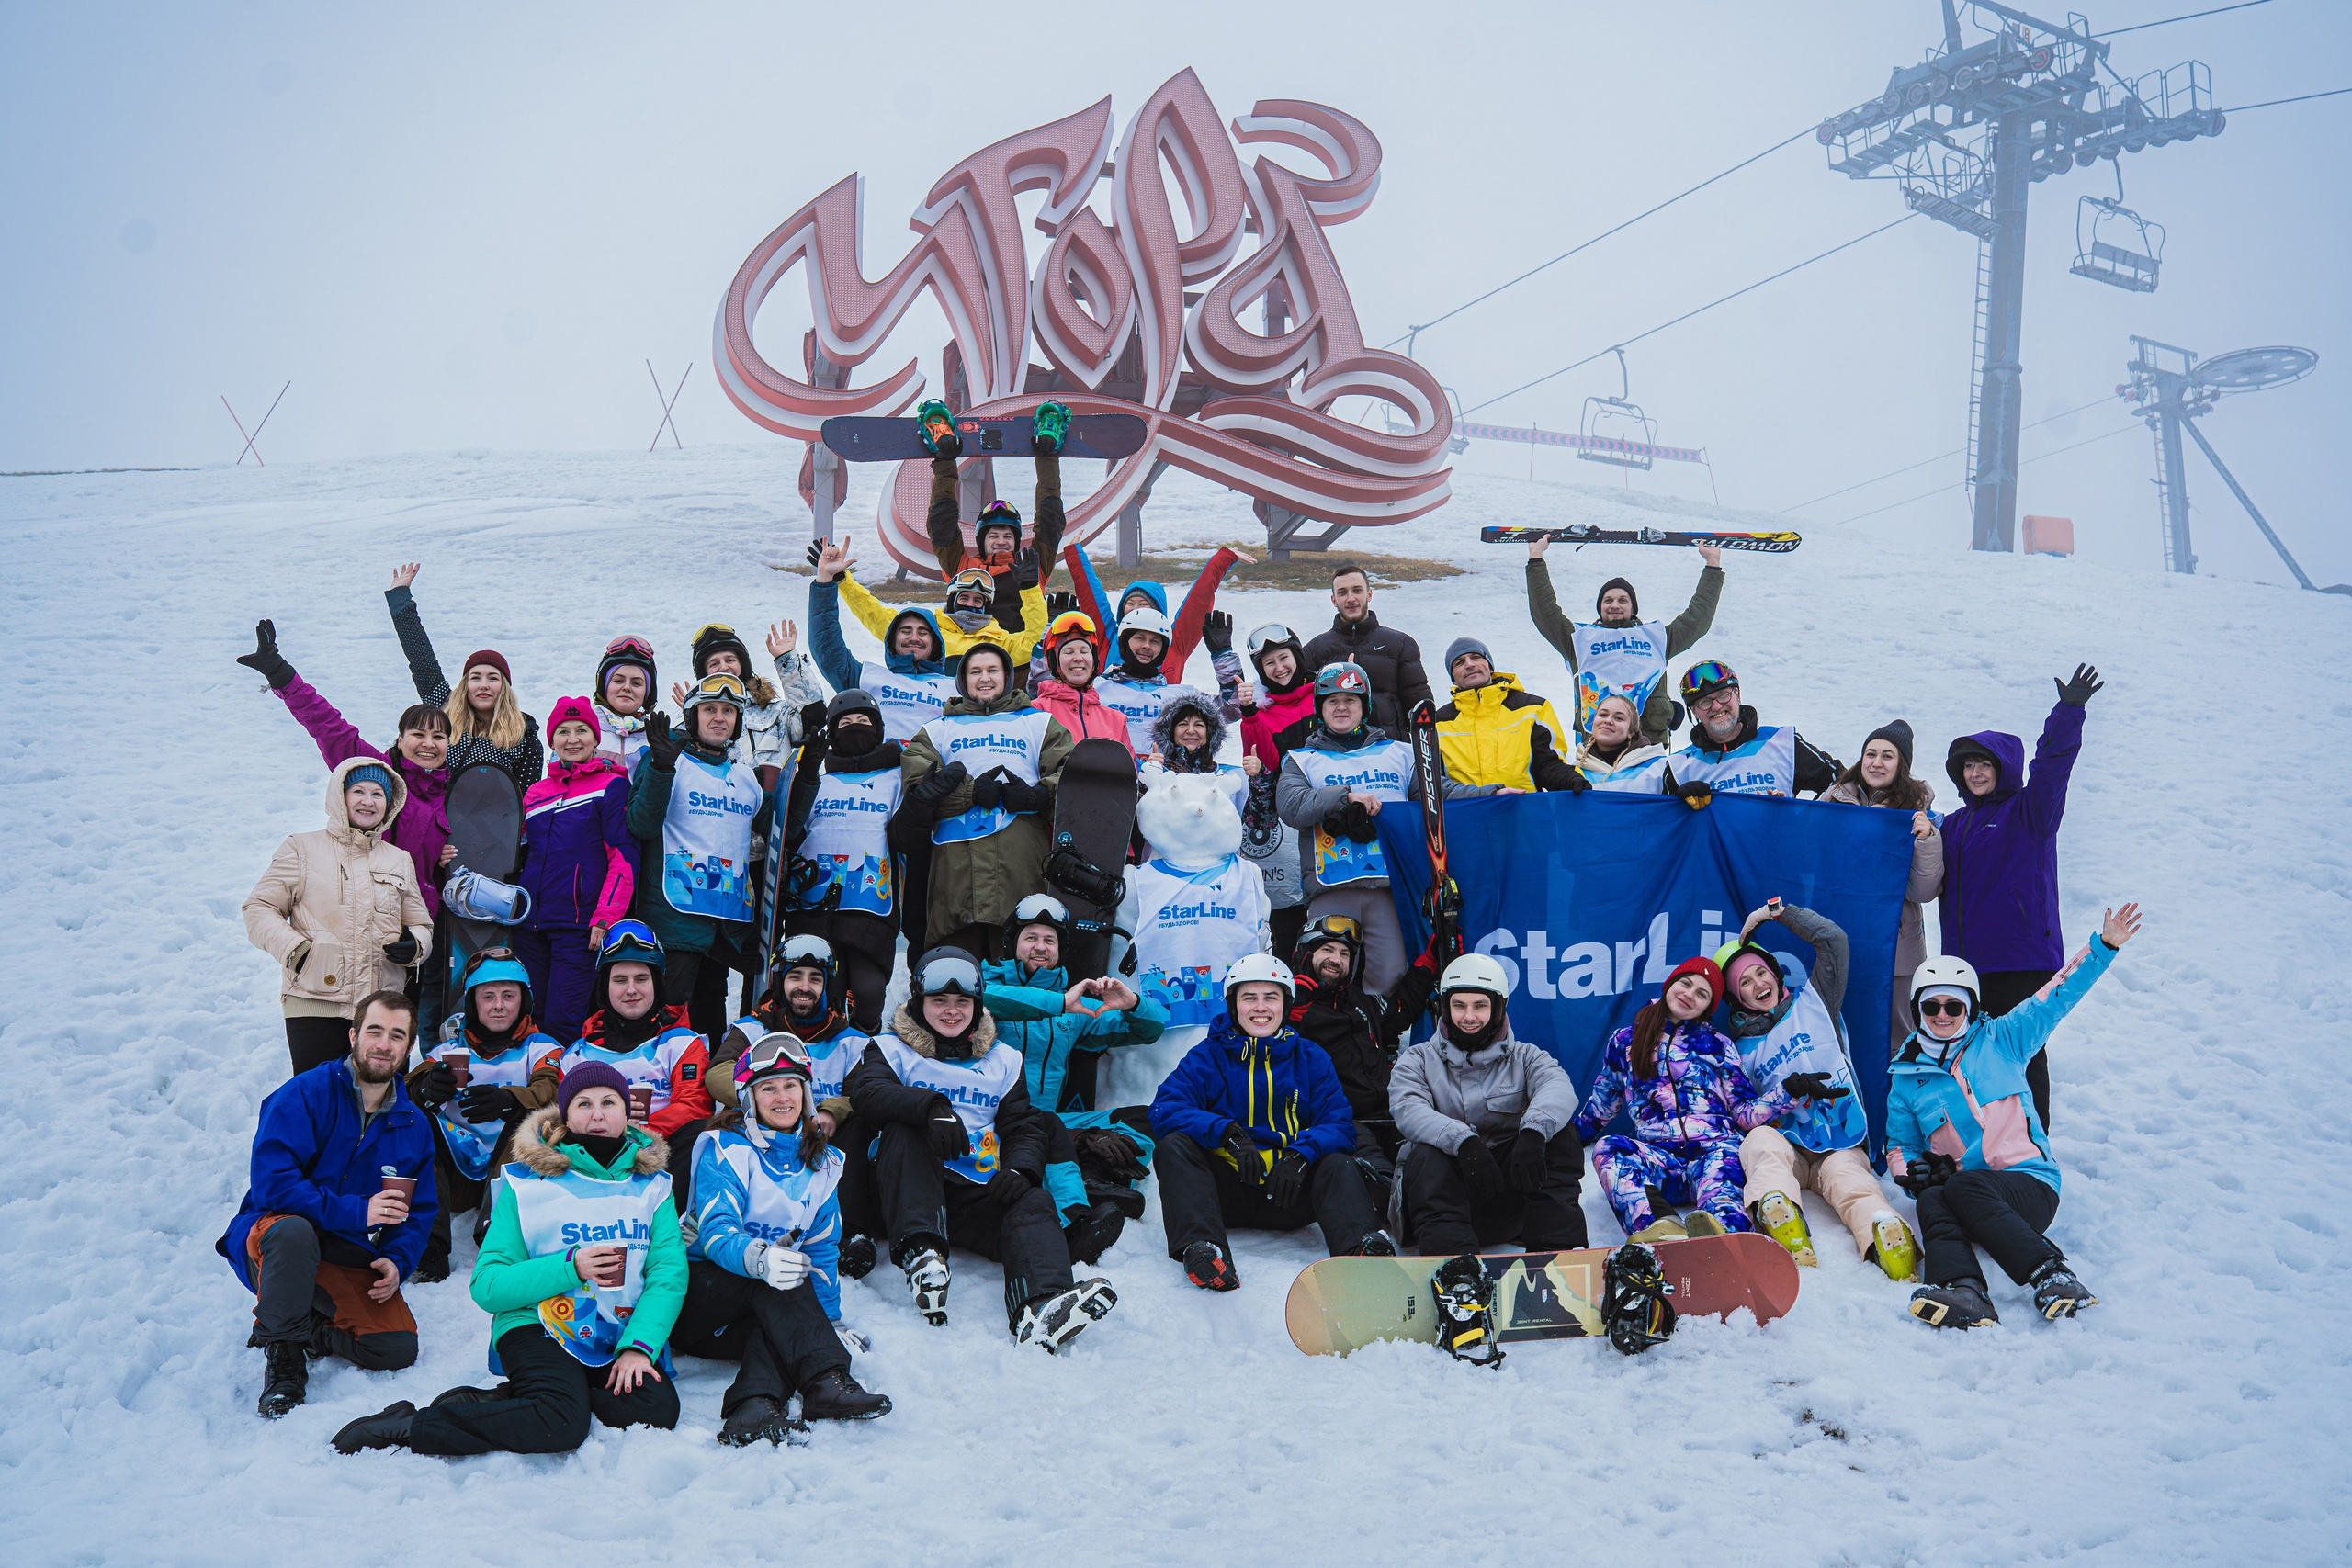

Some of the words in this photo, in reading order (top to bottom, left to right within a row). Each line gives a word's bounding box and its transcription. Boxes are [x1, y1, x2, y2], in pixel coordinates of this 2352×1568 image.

[1590, 637, 1651, 655] StarLine
[950, 734, 1027, 753] StarLine
[1325, 769, 1399, 786] StarLine
[1419, 728, 1437, 815] FISCHER
[1707, 772, 1775, 790] tarLine
[688, 791, 752, 816] StarLine
[814, 797, 888, 815] StarLine
[1159, 902, 1236, 919] StarLine
[1474, 909, 1809, 1000] StarLie
[561, 1218, 650, 1245] StarLin
